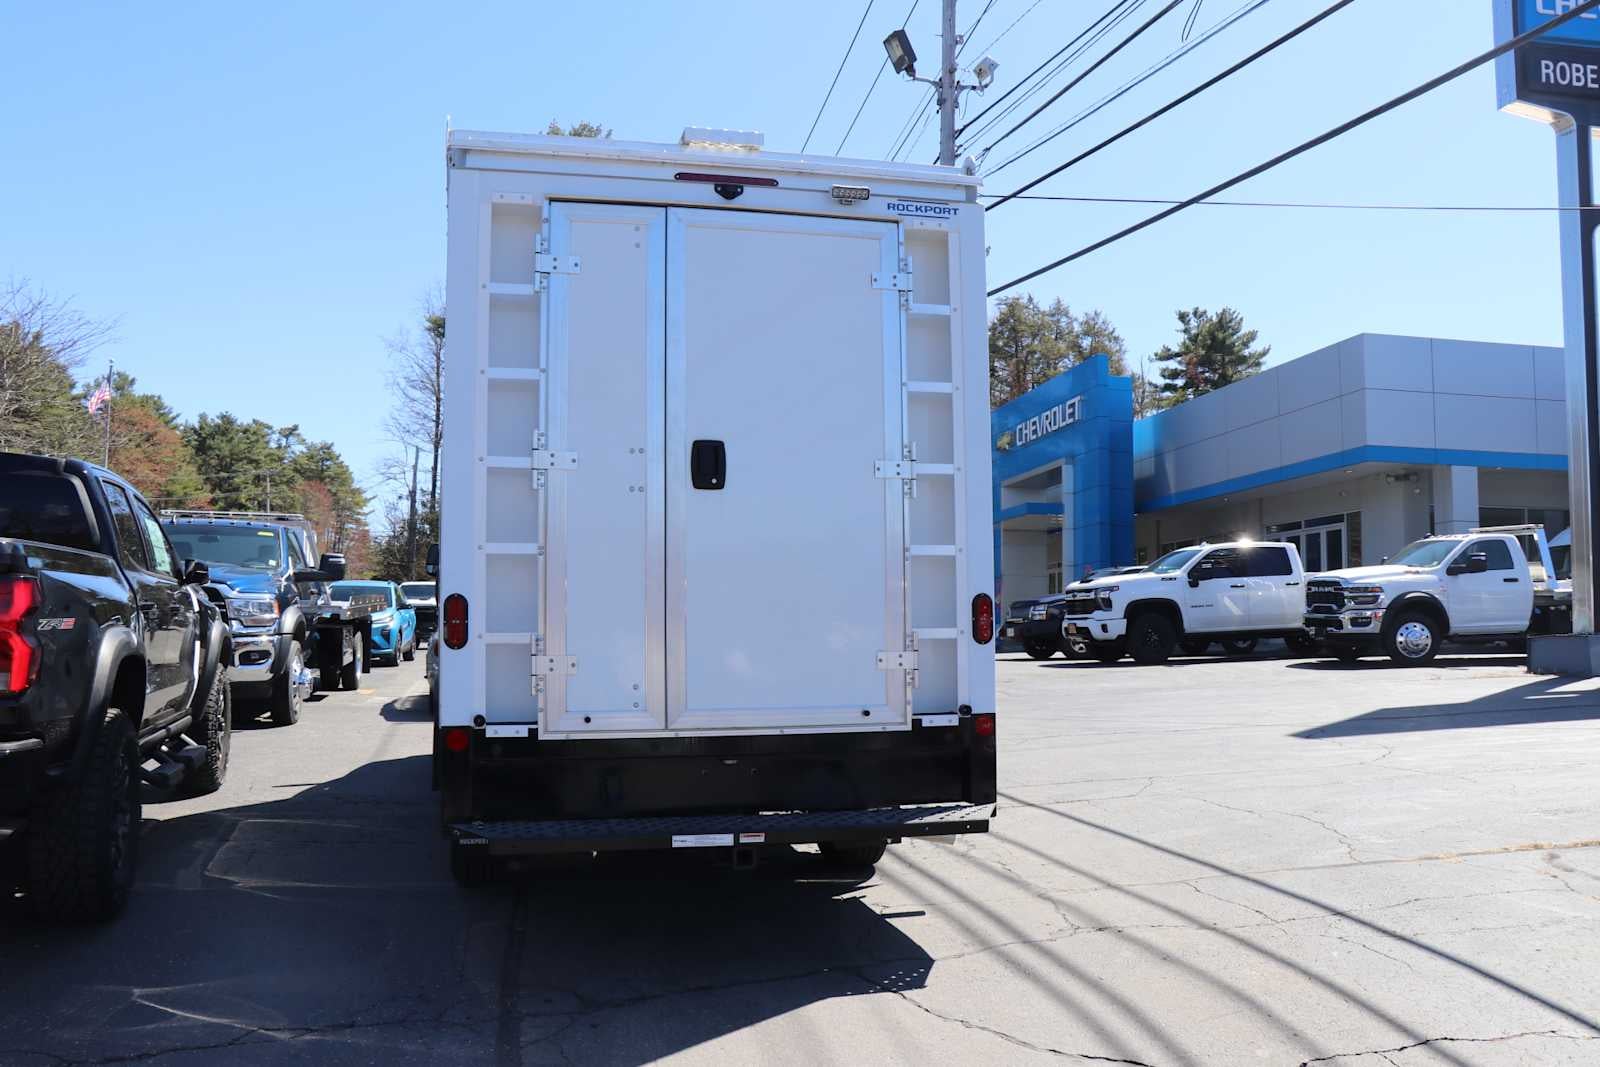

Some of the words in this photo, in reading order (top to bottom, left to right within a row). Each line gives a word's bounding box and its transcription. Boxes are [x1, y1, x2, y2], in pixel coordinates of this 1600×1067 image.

[1540, 60, 1599, 88] ROBE
[887, 203, 960, 216] ROCKPORT
[1016, 395, 1081, 446] CHEVROLET
